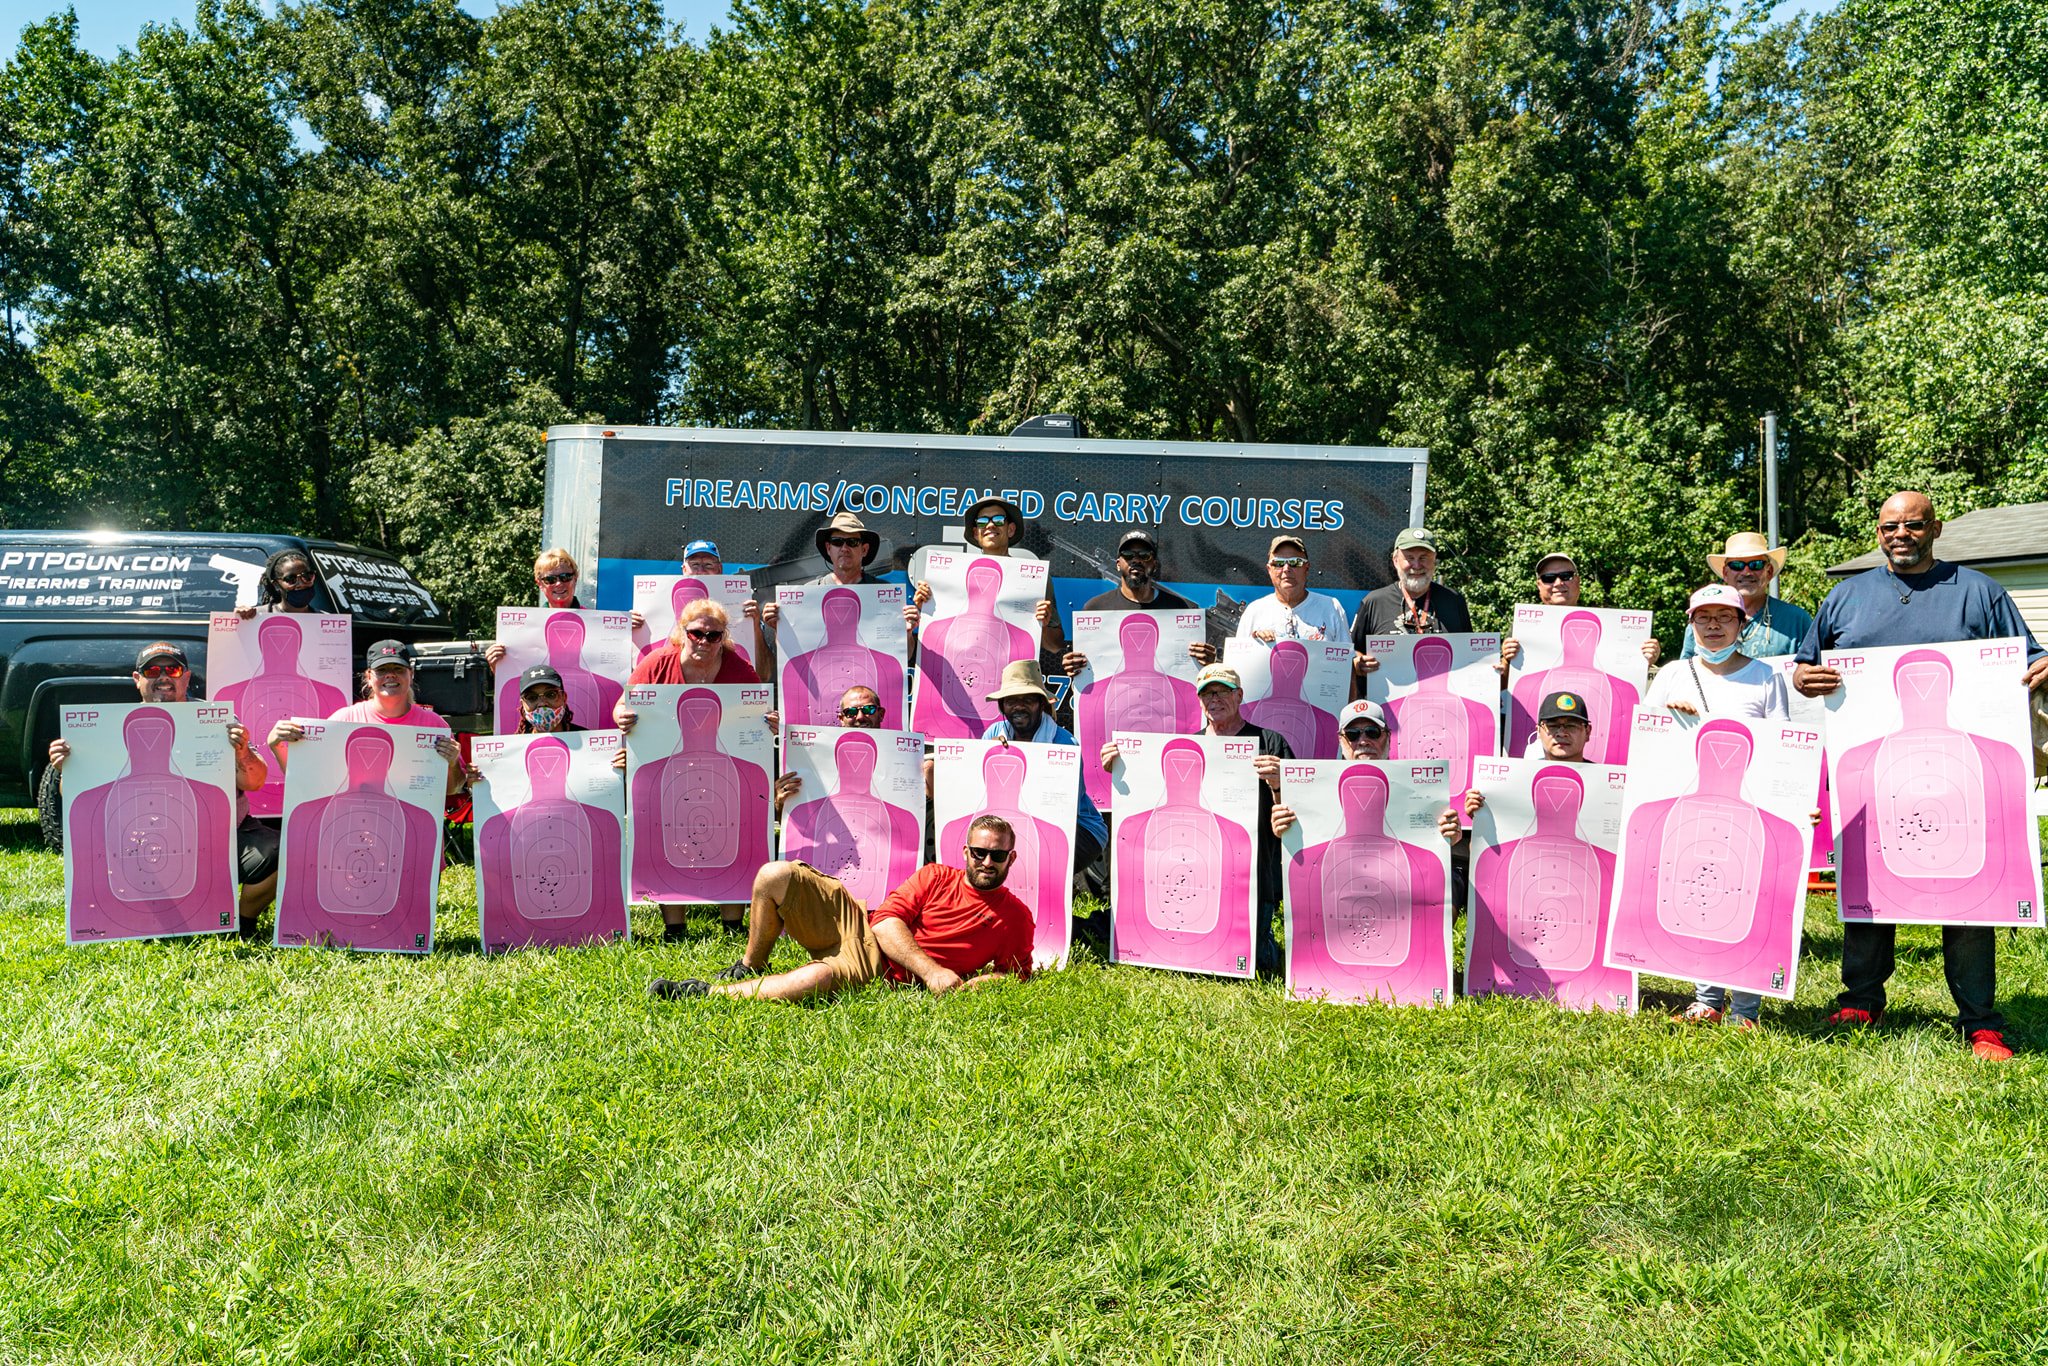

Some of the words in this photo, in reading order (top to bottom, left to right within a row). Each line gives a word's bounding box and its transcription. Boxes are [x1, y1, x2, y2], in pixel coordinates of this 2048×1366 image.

[666, 477, 1045, 521] FIREARMS/CONCEAED
[1054, 490, 1171, 525] CARRY
[1179, 495, 1345, 531] COURSES
[930, 556, 952, 565] PTP
[1020, 564, 1045, 574] PTP
[97, 576, 184, 591] TRAINING
[636, 581, 657, 589] PTP
[725, 580, 748, 588] PTP
[779, 591, 804, 600] PTP
[877, 589, 903, 598] PTP
[501, 612, 527, 621] PTP
[1518, 609, 1544, 618] PTP
[213, 618, 240, 627] PTP
[320, 619, 347, 628] PTP
[603, 616, 629, 625] PTP
[1076, 617, 1102, 626] PTP
[1176, 615, 1202, 624] PTP
[1620, 616, 1648, 625] PTP
[1370, 640, 1395, 648] PTP
[1470, 638, 1496, 647] PTP
[1325, 647, 1350, 657] PTP
[1980, 646, 2019, 660] PTP
[1827, 656, 1865, 669] PTP
[628, 690, 657, 700] PTP
[741, 690, 769, 700] PTP
[65, 711, 99, 722] PTP
[197, 707, 229, 718] PTP
[1637, 713, 1673, 727] PTP
[304, 725, 326, 736] TP
[589, 735, 618, 746] PTP
[789, 731, 817, 741] PTP
[1781, 729, 1819, 743] PTP
[476, 742, 505, 753] PTP
[896, 737, 921, 748] PTP
[1116, 738, 1142, 749] PTP
[1782, 742, 1815, 751] GUN.COM
[938, 745, 965, 755] PTP
[1224, 743, 1254, 754] PTP
[1047, 749, 1076, 761] PTP
[1285, 767, 1316, 778] PTP
[1411, 767, 1444, 778] PTP
[1478, 763, 1510, 775] PTP
[1608, 772, 1627, 784] PT
